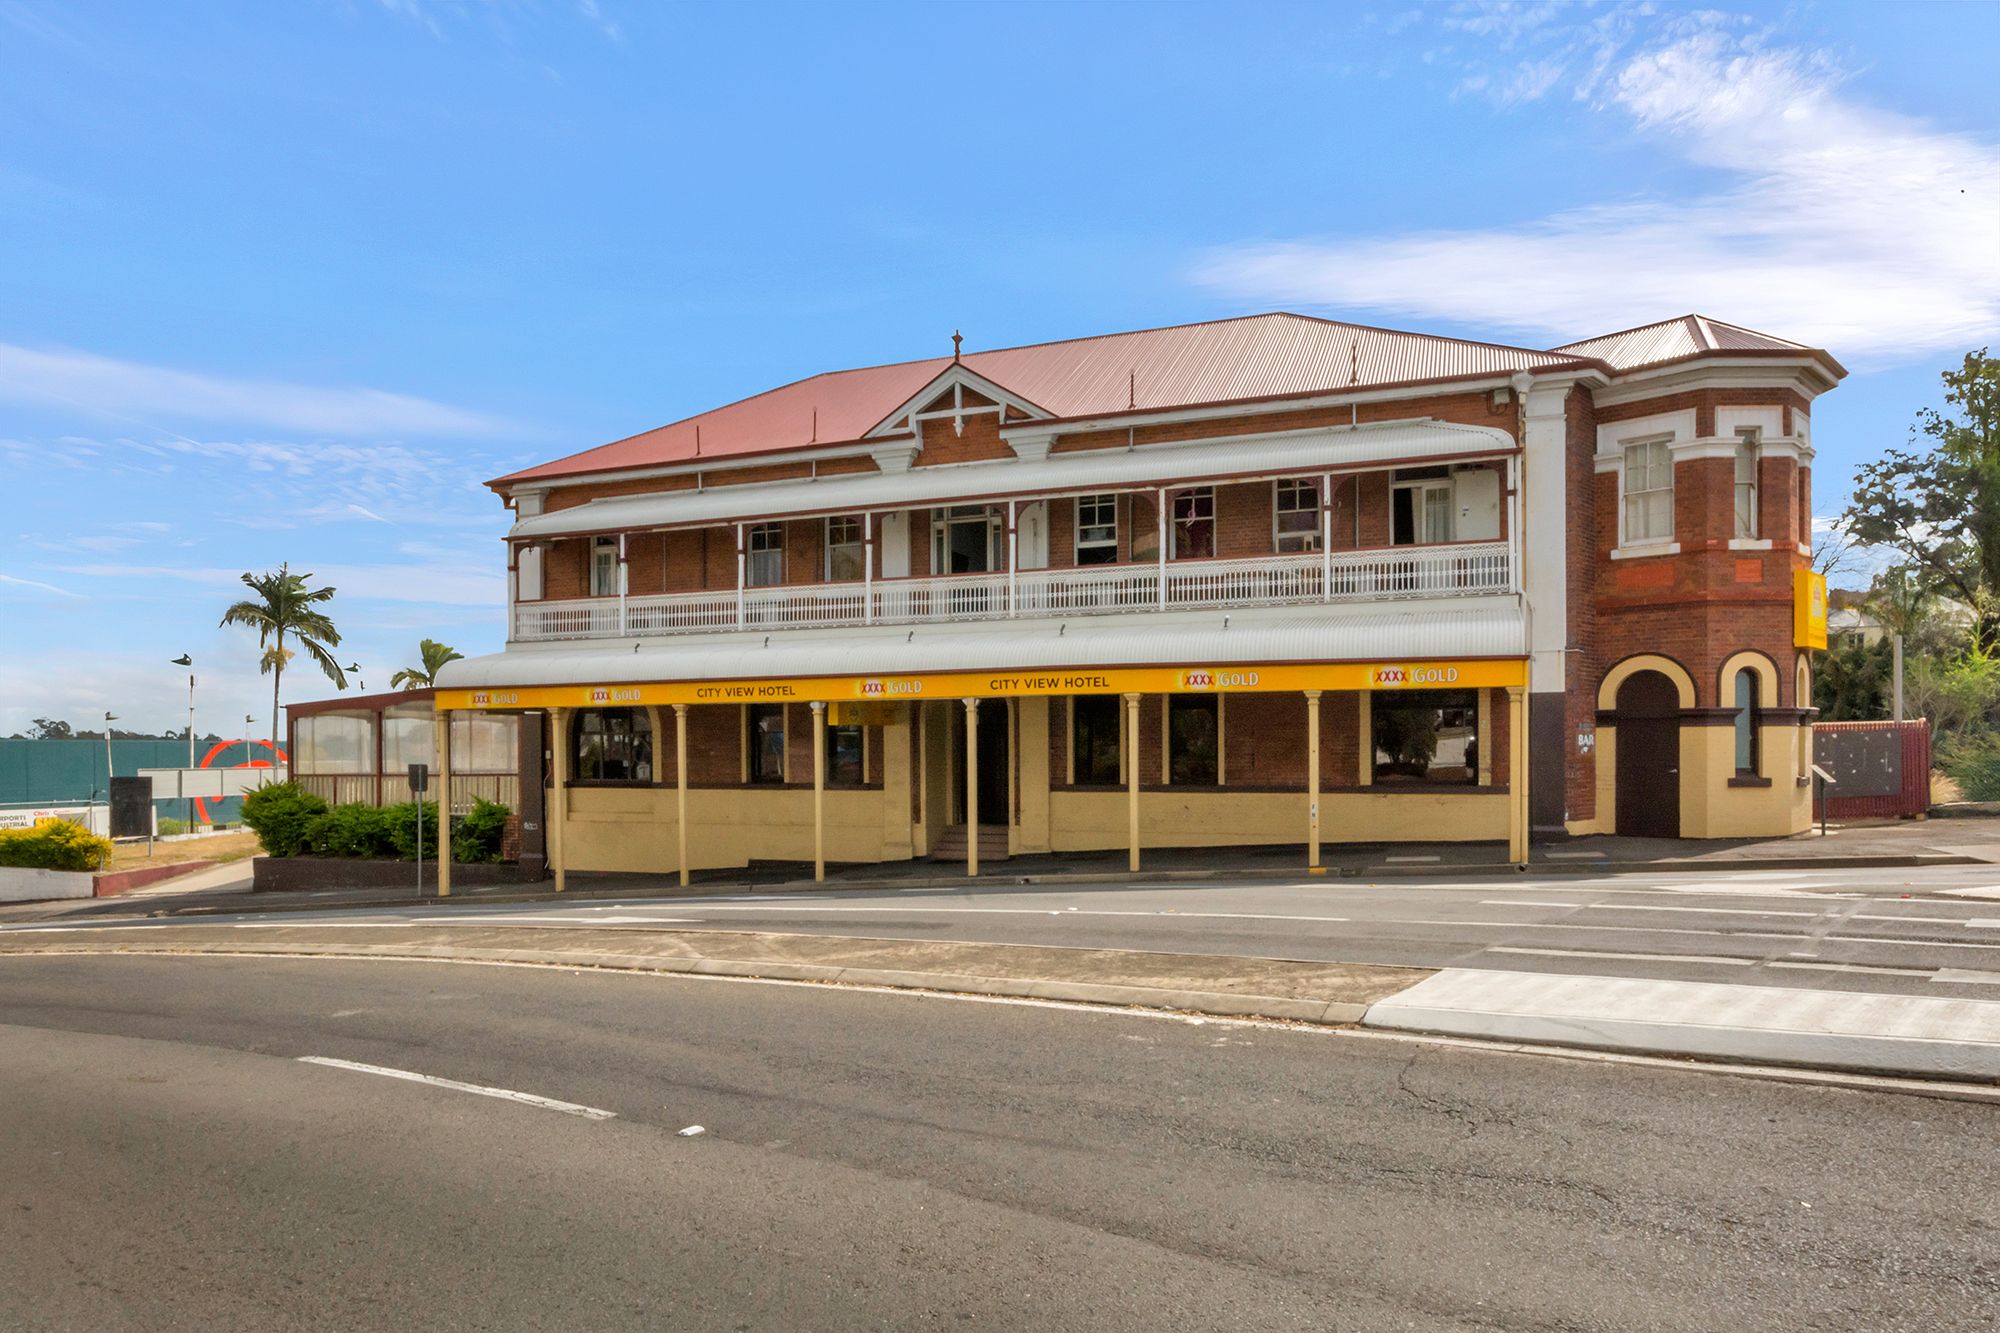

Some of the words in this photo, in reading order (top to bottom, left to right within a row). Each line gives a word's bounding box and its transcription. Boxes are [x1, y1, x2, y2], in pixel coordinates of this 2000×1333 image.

[1185, 674, 1214, 685] XXXX
[1219, 672, 1259, 687] GOLD
[1375, 670, 1408, 682] XXXX
[1414, 667, 1458, 683] GOLD
[861, 683, 886, 694] XXXX
[889, 680, 922, 694] GOLD
[990, 679, 1019, 690] CITY
[1024, 678, 1060, 688] VIEW
[1065, 676, 1109, 688] HOTEL
[493, 693, 518, 704] GOLD
[613, 688, 641, 702] GOLD
[697, 688, 721, 698] CITY
[725, 687, 755, 697] VIEW
[758, 686, 796, 696] HOTEL
[1578, 734, 1594, 746] BAR
